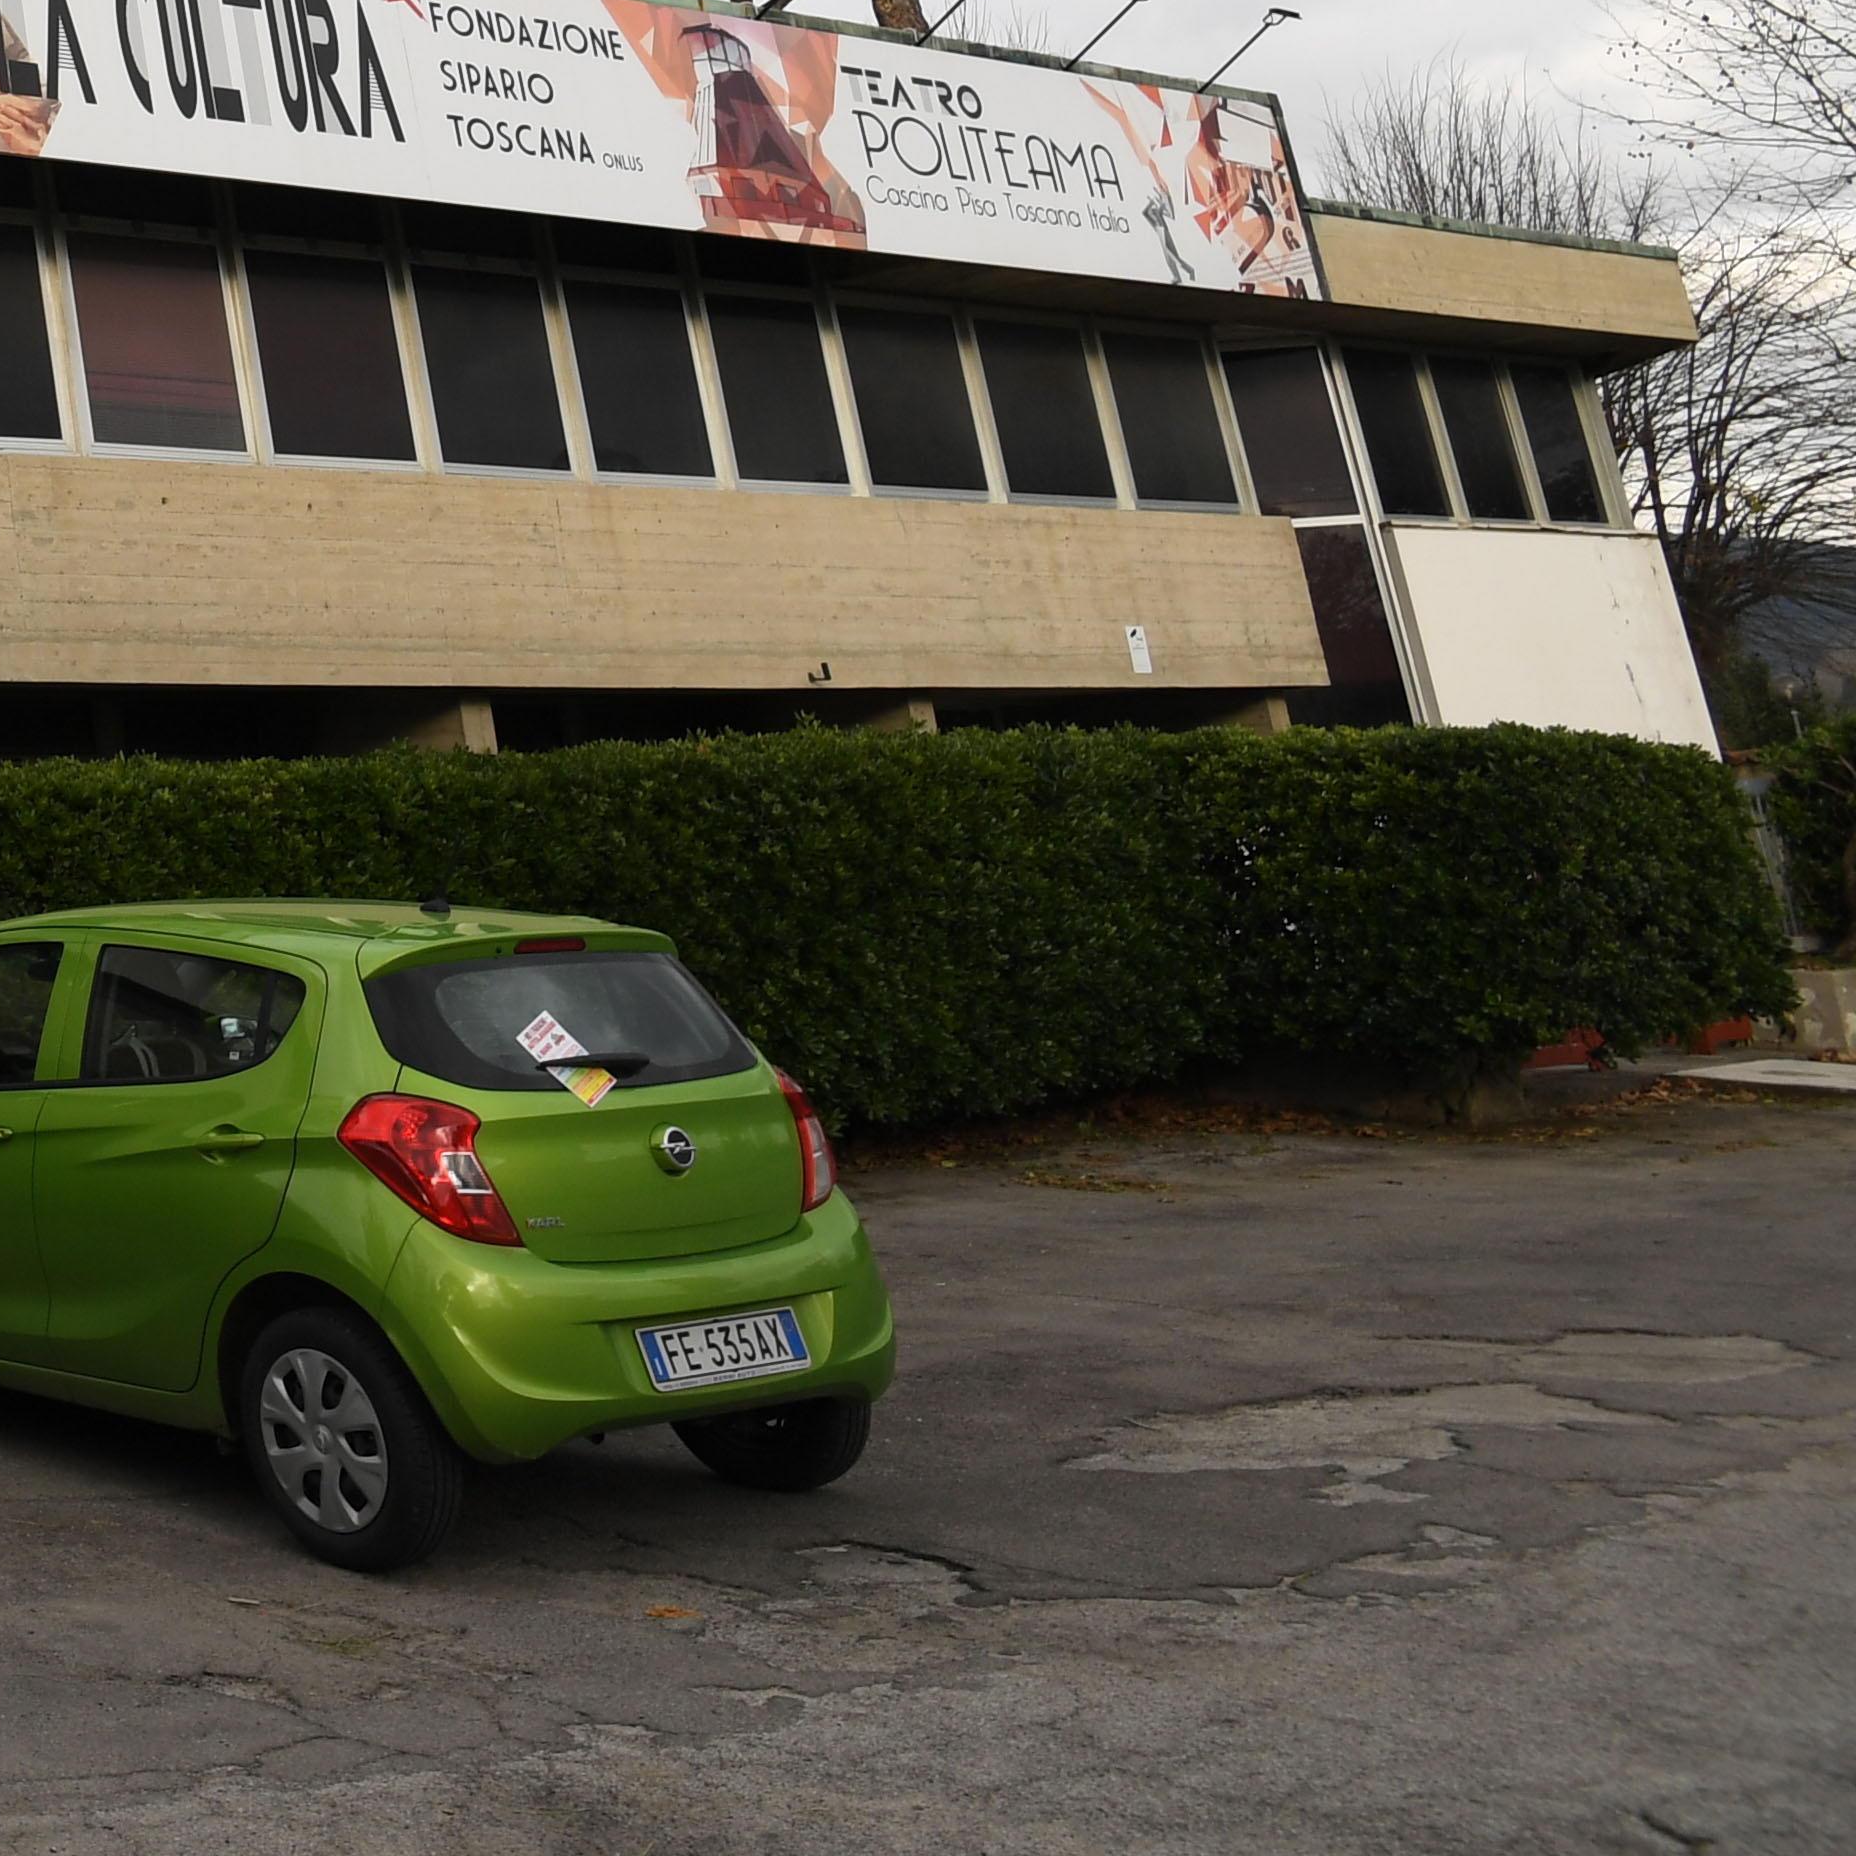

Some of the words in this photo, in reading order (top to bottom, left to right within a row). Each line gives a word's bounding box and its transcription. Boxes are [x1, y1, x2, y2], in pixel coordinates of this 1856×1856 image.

[428, 1, 625, 62] FONDAZIONE
[439, 59, 555, 105] SIPARIO
[840, 65, 983, 120] TEATRO
[446, 114, 596, 165] TOSCANA
[601, 152, 644, 173] ONLUS
[851, 109, 1125, 202] POLITEAMA
[866, 174, 950, 213] Cascina
[955, 186, 998, 218] Pisa
[1002, 192, 1083, 229] Toscana
[1087, 202, 1131, 234] Italia
[660, 1331, 702, 1375] FE
[704, 1317, 790, 1367] 535AX
